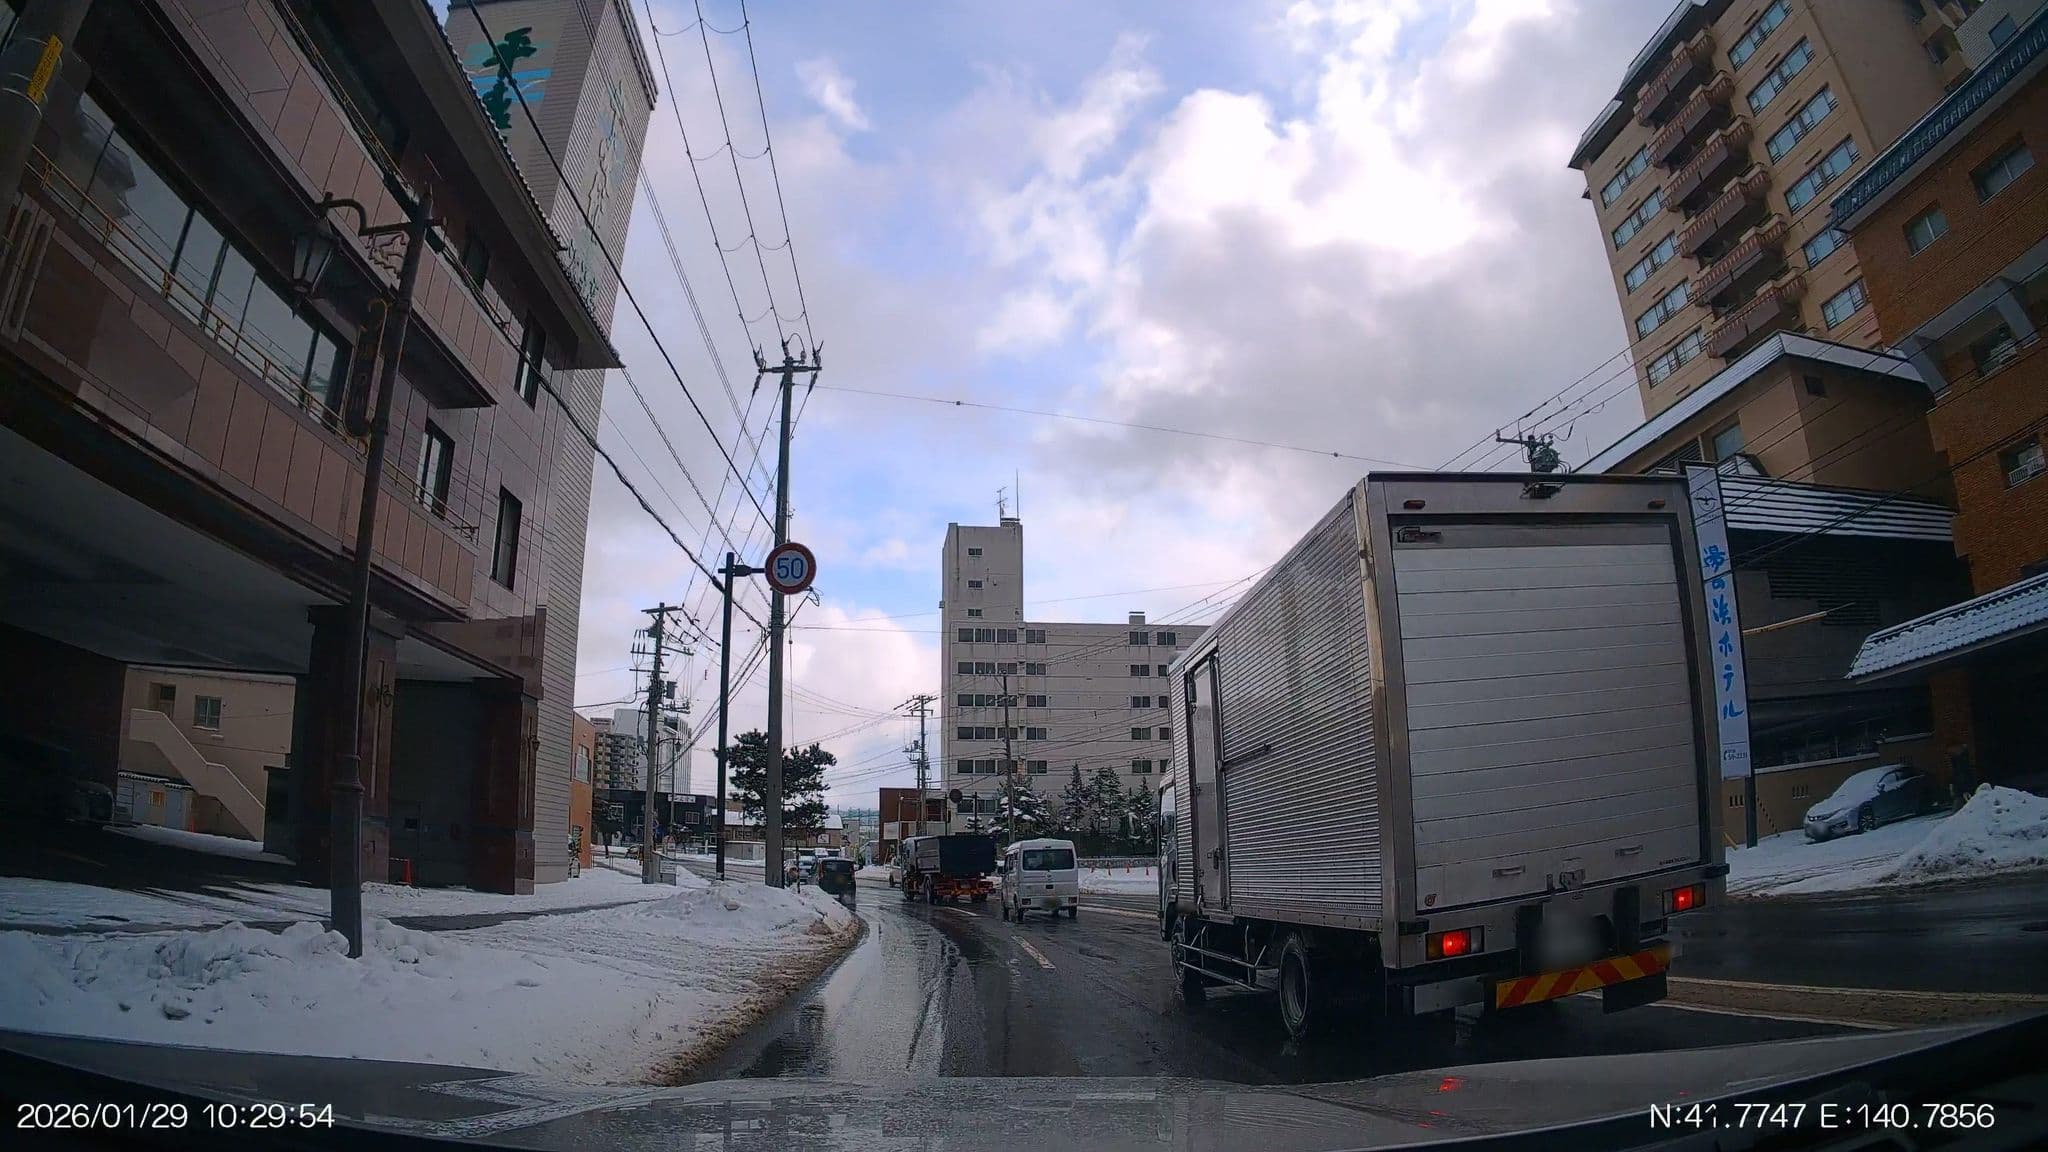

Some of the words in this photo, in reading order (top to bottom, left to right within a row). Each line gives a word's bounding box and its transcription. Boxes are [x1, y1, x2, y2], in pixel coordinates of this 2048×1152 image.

[777, 557, 804, 579] 50
[1703, 544, 1744, 720] 湯の浜ホテル
